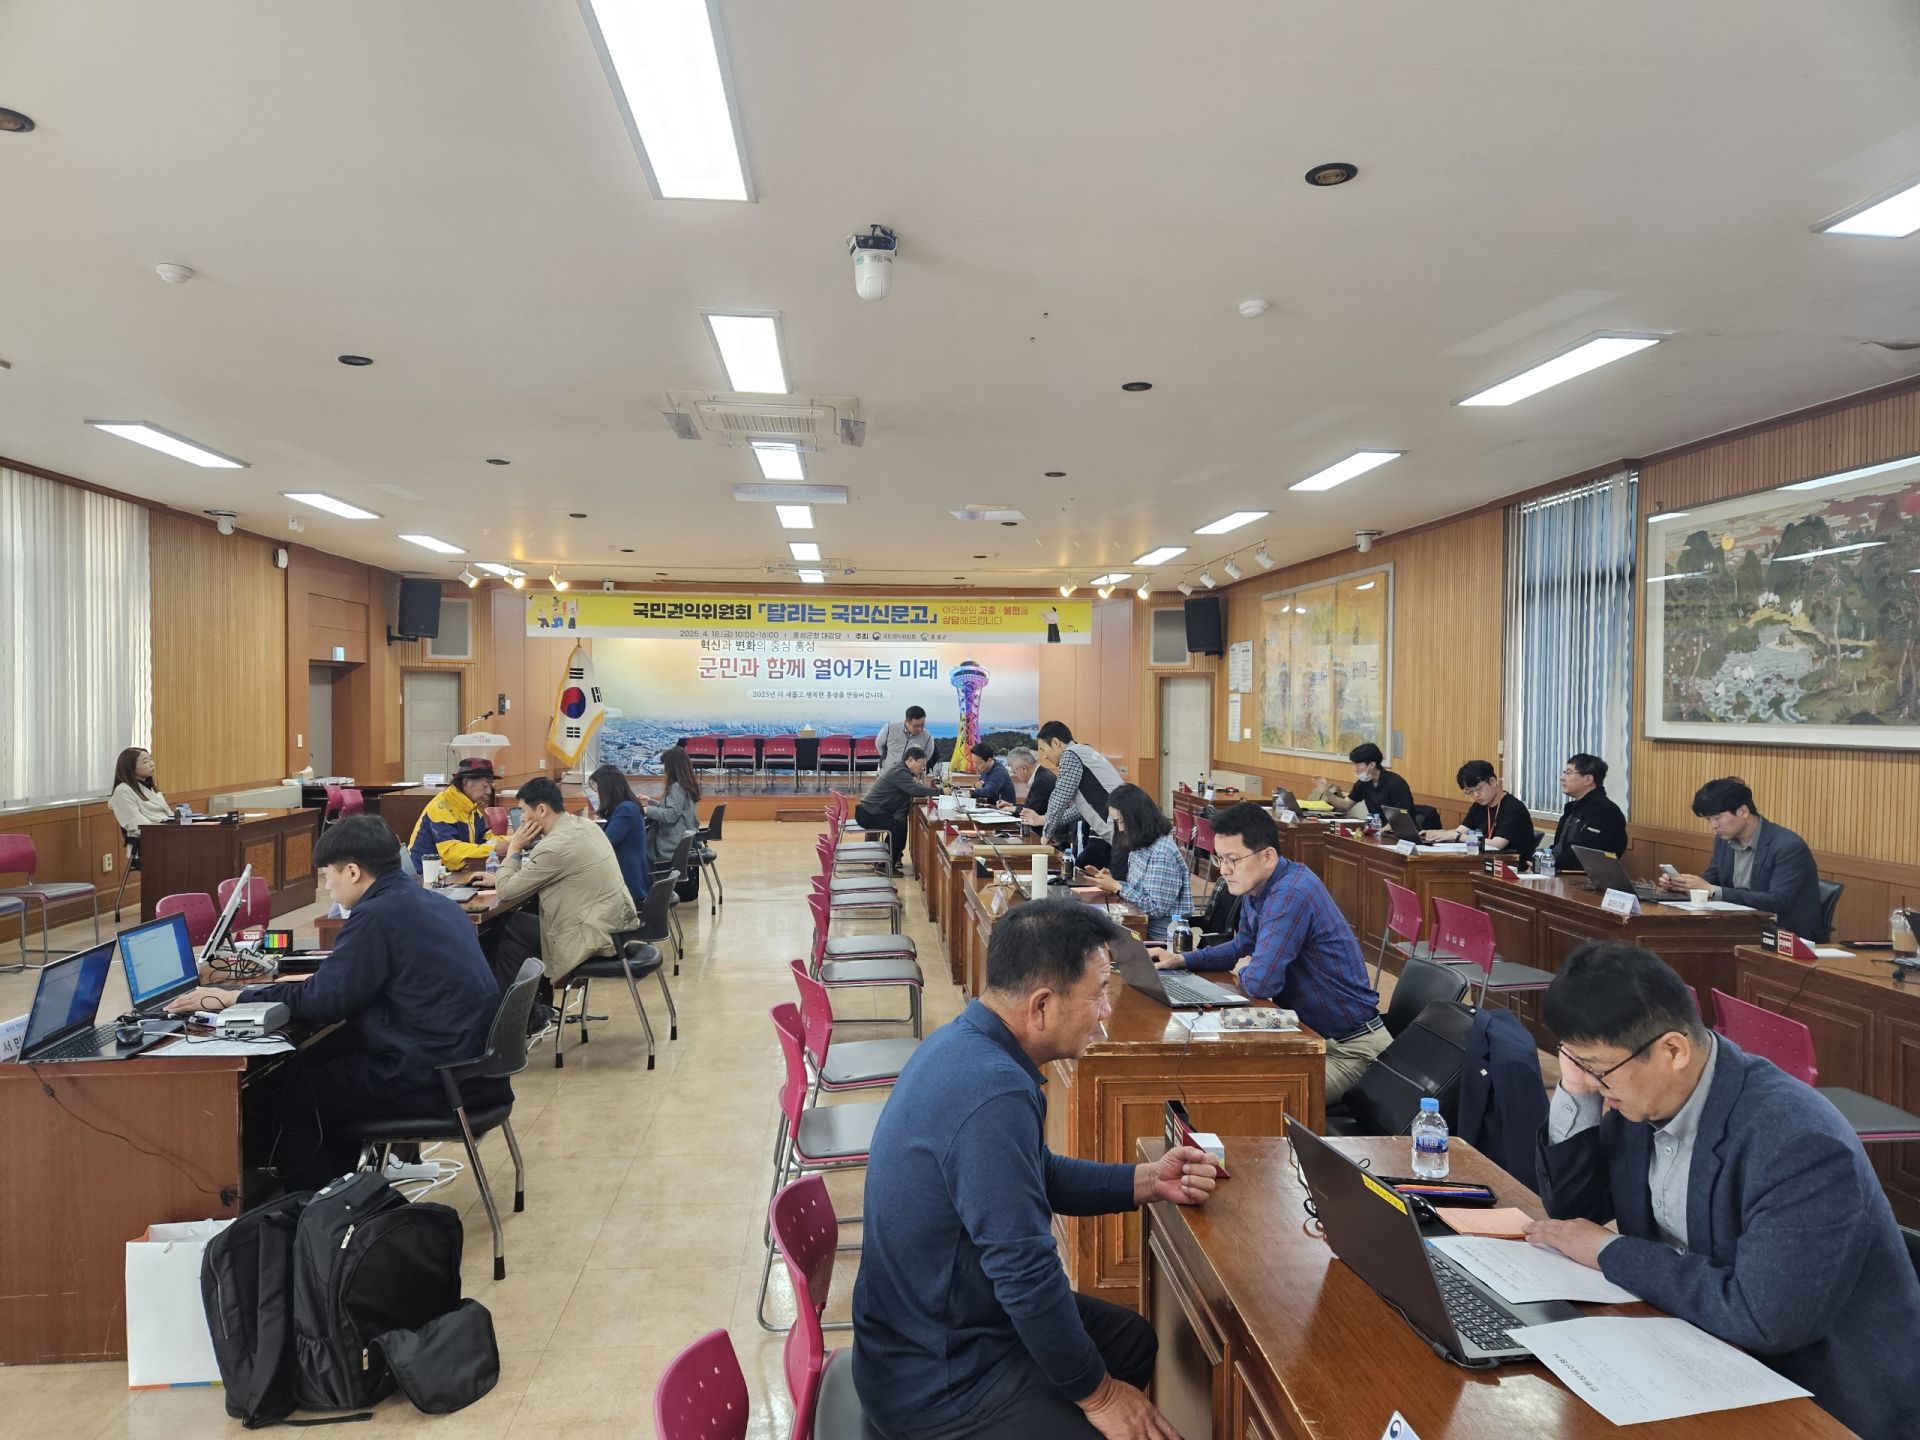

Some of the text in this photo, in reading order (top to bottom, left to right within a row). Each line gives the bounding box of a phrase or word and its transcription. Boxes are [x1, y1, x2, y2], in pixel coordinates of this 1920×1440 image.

[633, 602, 937, 624] 국민권익위원회 「달리는 국민신문고」
[943, 605, 1029, 616] 여러분의 고충 불편을
[942, 616, 1003, 625] 상담해드립니다
[680, 630, 701, 638] 2025.
[855, 633, 869, 641] 주최
[701, 639, 731, 651] 혁신과
[736, 639, 766, 652] 변화의
[795, 640, 815, 652] 홍성
[698, 657, 938, 680] 군민과 함께 열어가는 미래
[752, 690, 776, 698] 2025년
[777, 690, 784, 698] 더
